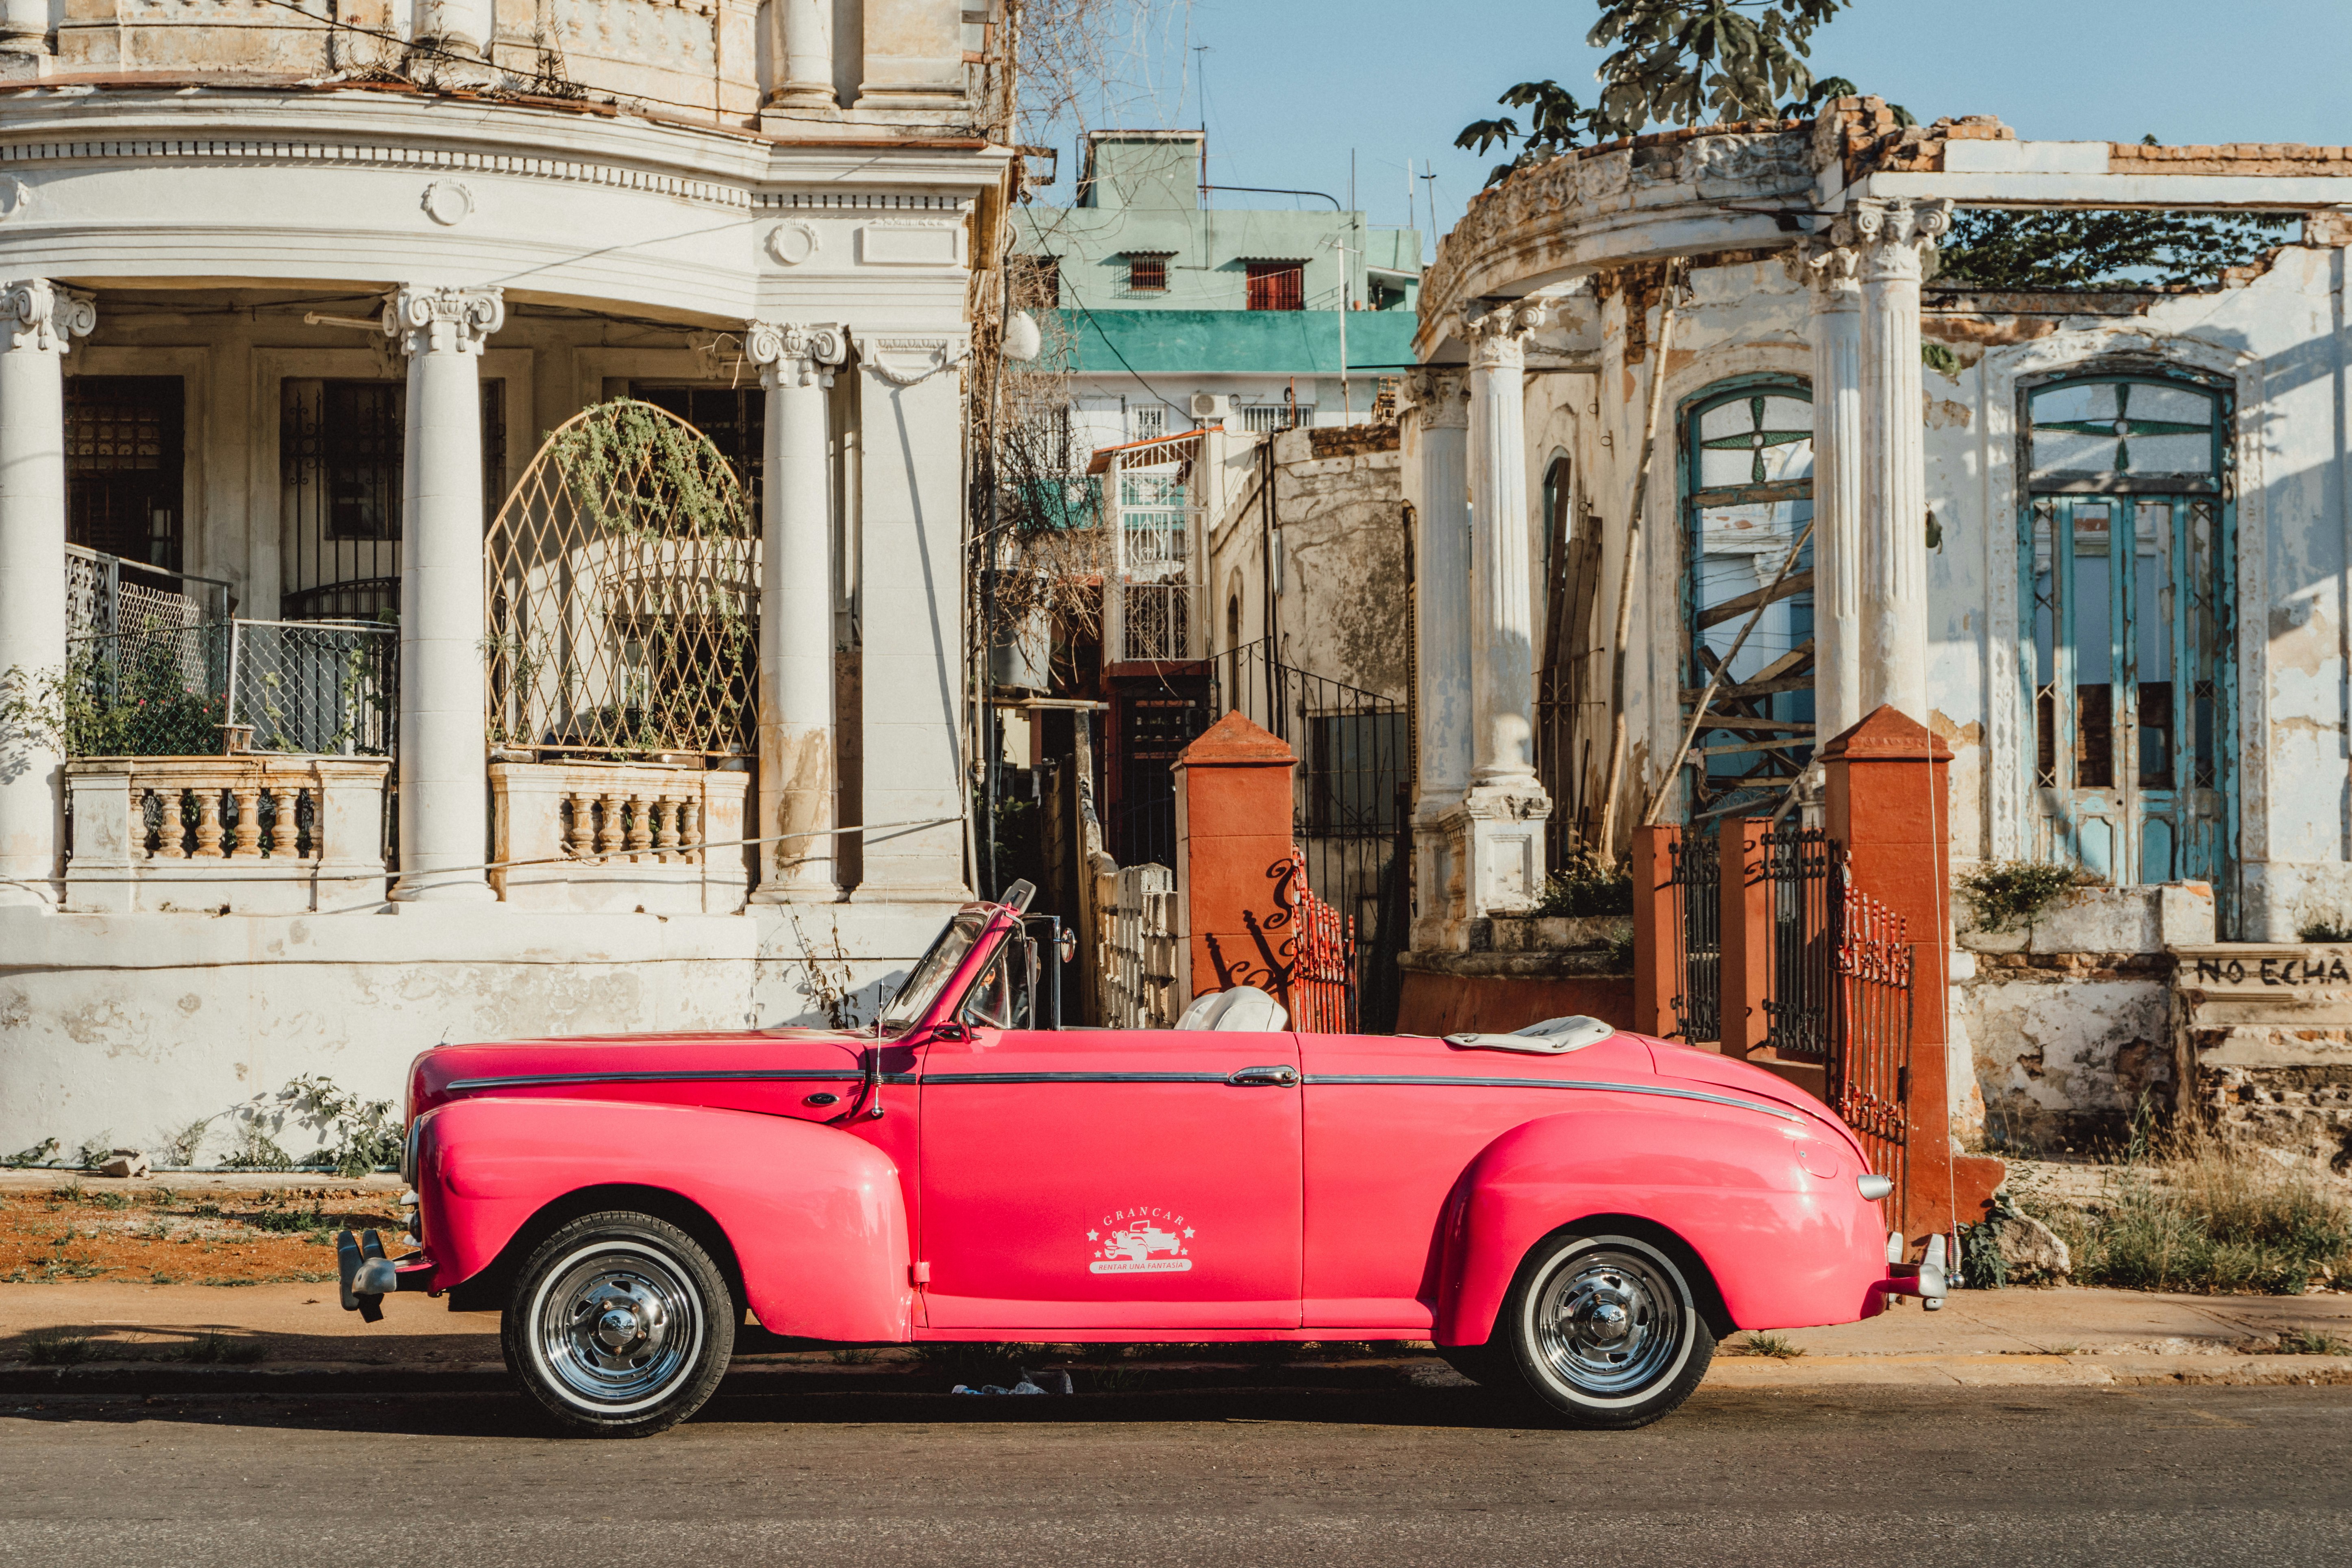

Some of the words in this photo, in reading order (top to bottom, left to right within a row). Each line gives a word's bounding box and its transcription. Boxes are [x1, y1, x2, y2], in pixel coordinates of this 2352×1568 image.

[2197, 958, 2244, 985] NO
[2260, 958, 2352, 985] ECHA
[1103, 1207, 1184, 1225] GRANCAR
